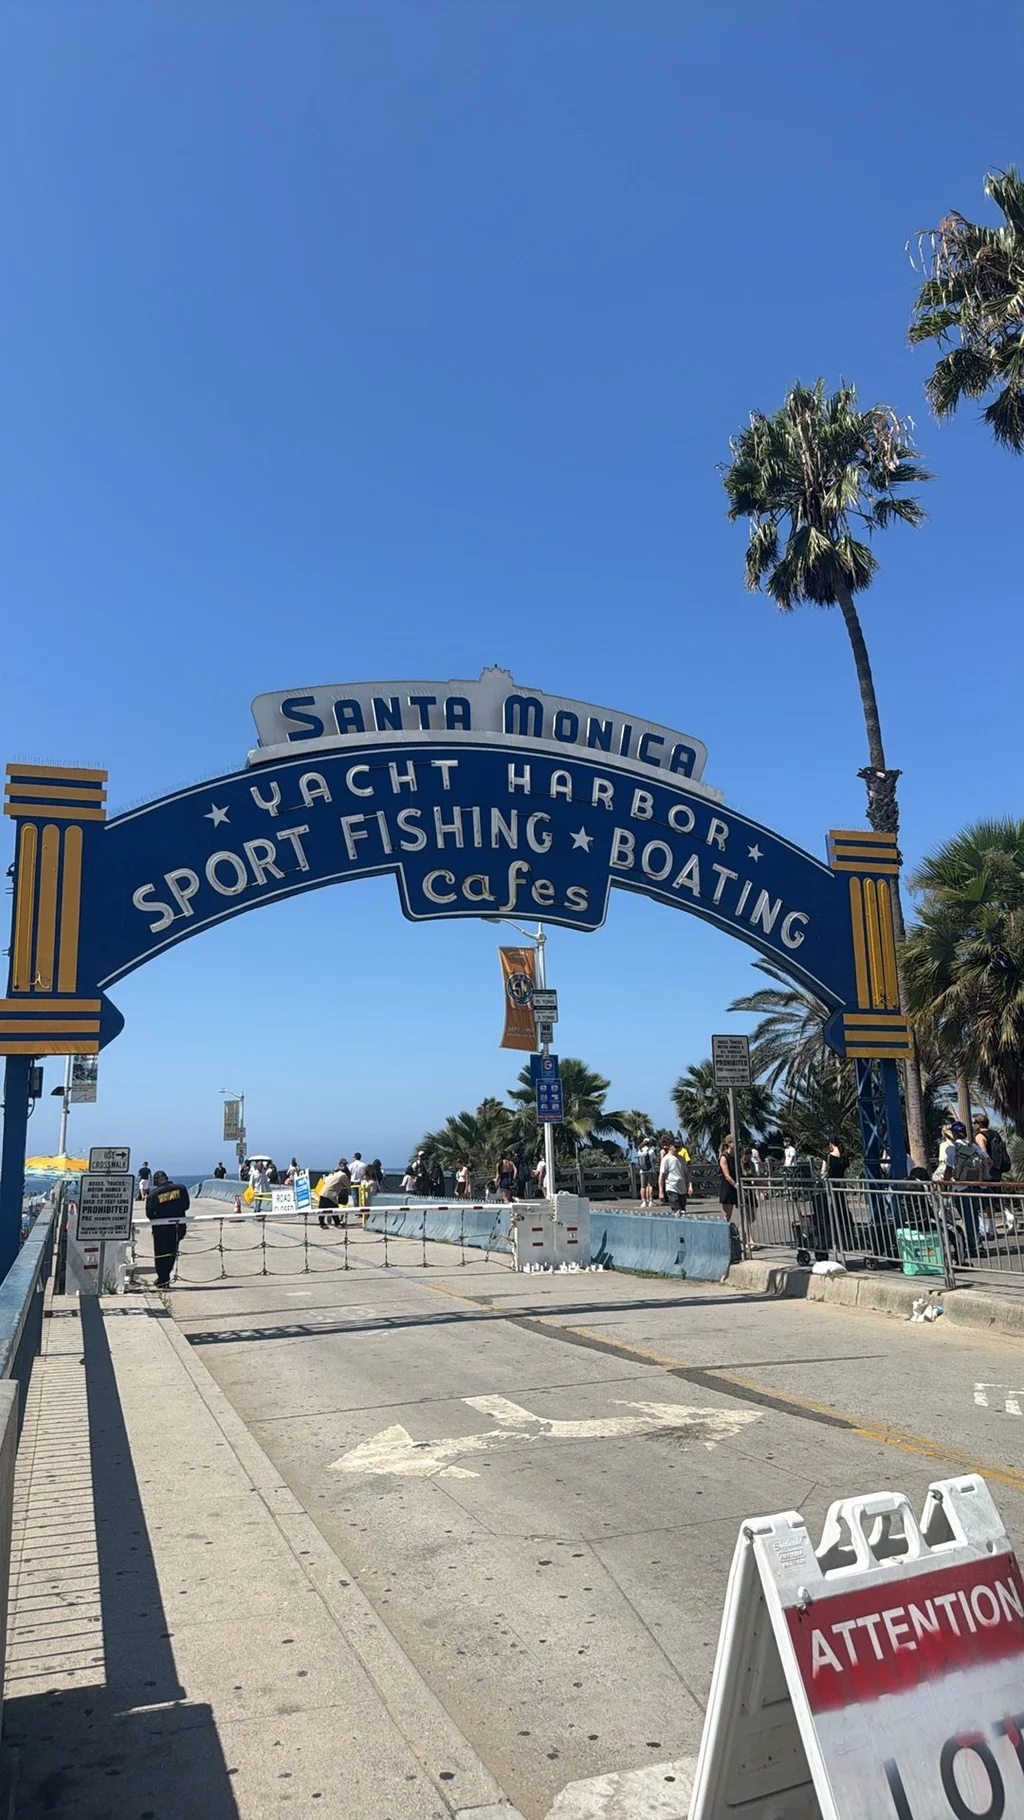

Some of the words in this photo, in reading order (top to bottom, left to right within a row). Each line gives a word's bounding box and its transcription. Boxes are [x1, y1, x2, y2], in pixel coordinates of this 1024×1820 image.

[281, 694, 471, 742] SANTA
[502, 693, 698, 778] MONICA
[250, 760, 459, 817] YACHT
[508, 763, 730, 851] HARBOR
[132, 824, 310, 934] SPORT
[340, 806, 553, 860] FISHING
[609, 827, 811, 949] BOATING
[91, 1161, 127, 1169] CROSSWALK
[103, 1151, 116, 1159] USE
[82, 1205, 129, 1214] PROHIBITED
[276, 1193, 291, 1203] ROAD
[811, 1577, 1024, 1679] ATTENTION
